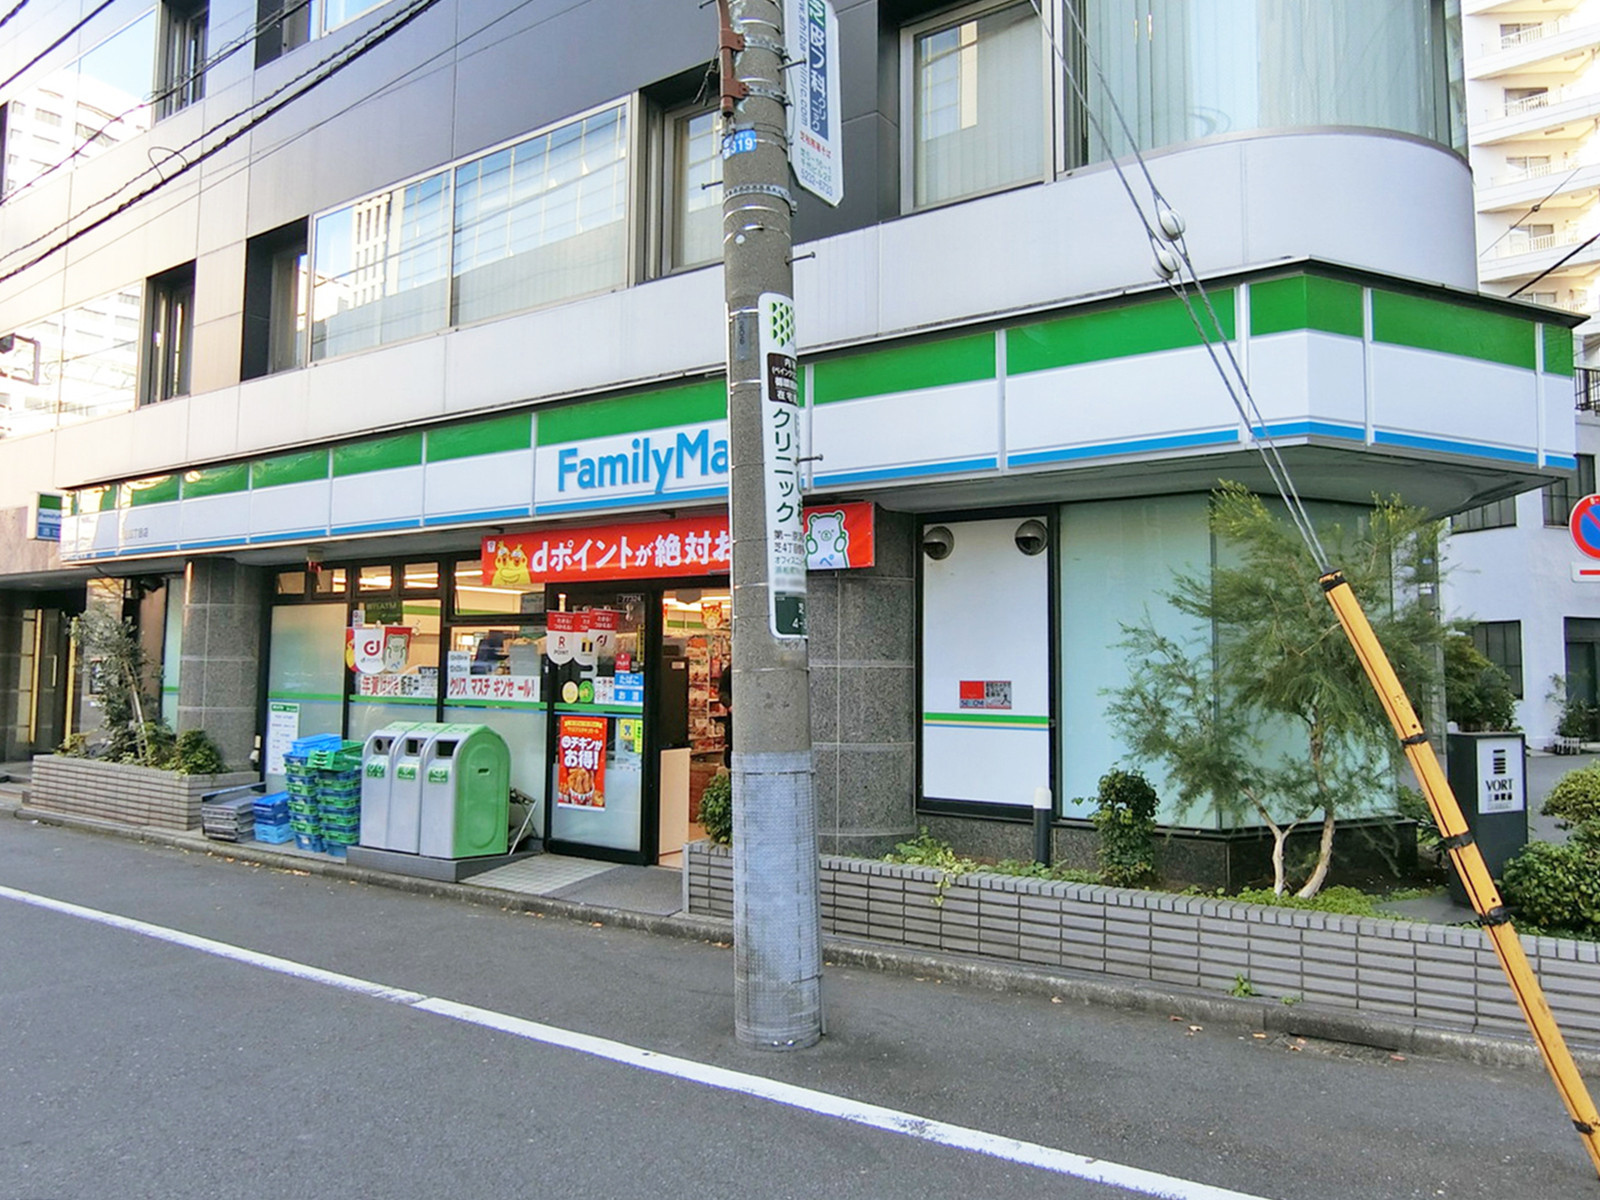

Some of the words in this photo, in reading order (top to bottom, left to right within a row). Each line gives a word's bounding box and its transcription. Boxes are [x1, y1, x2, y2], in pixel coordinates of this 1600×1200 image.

[773, 408, 794, 523] クリニック
[1485, 779, 1513, 791] VORT
